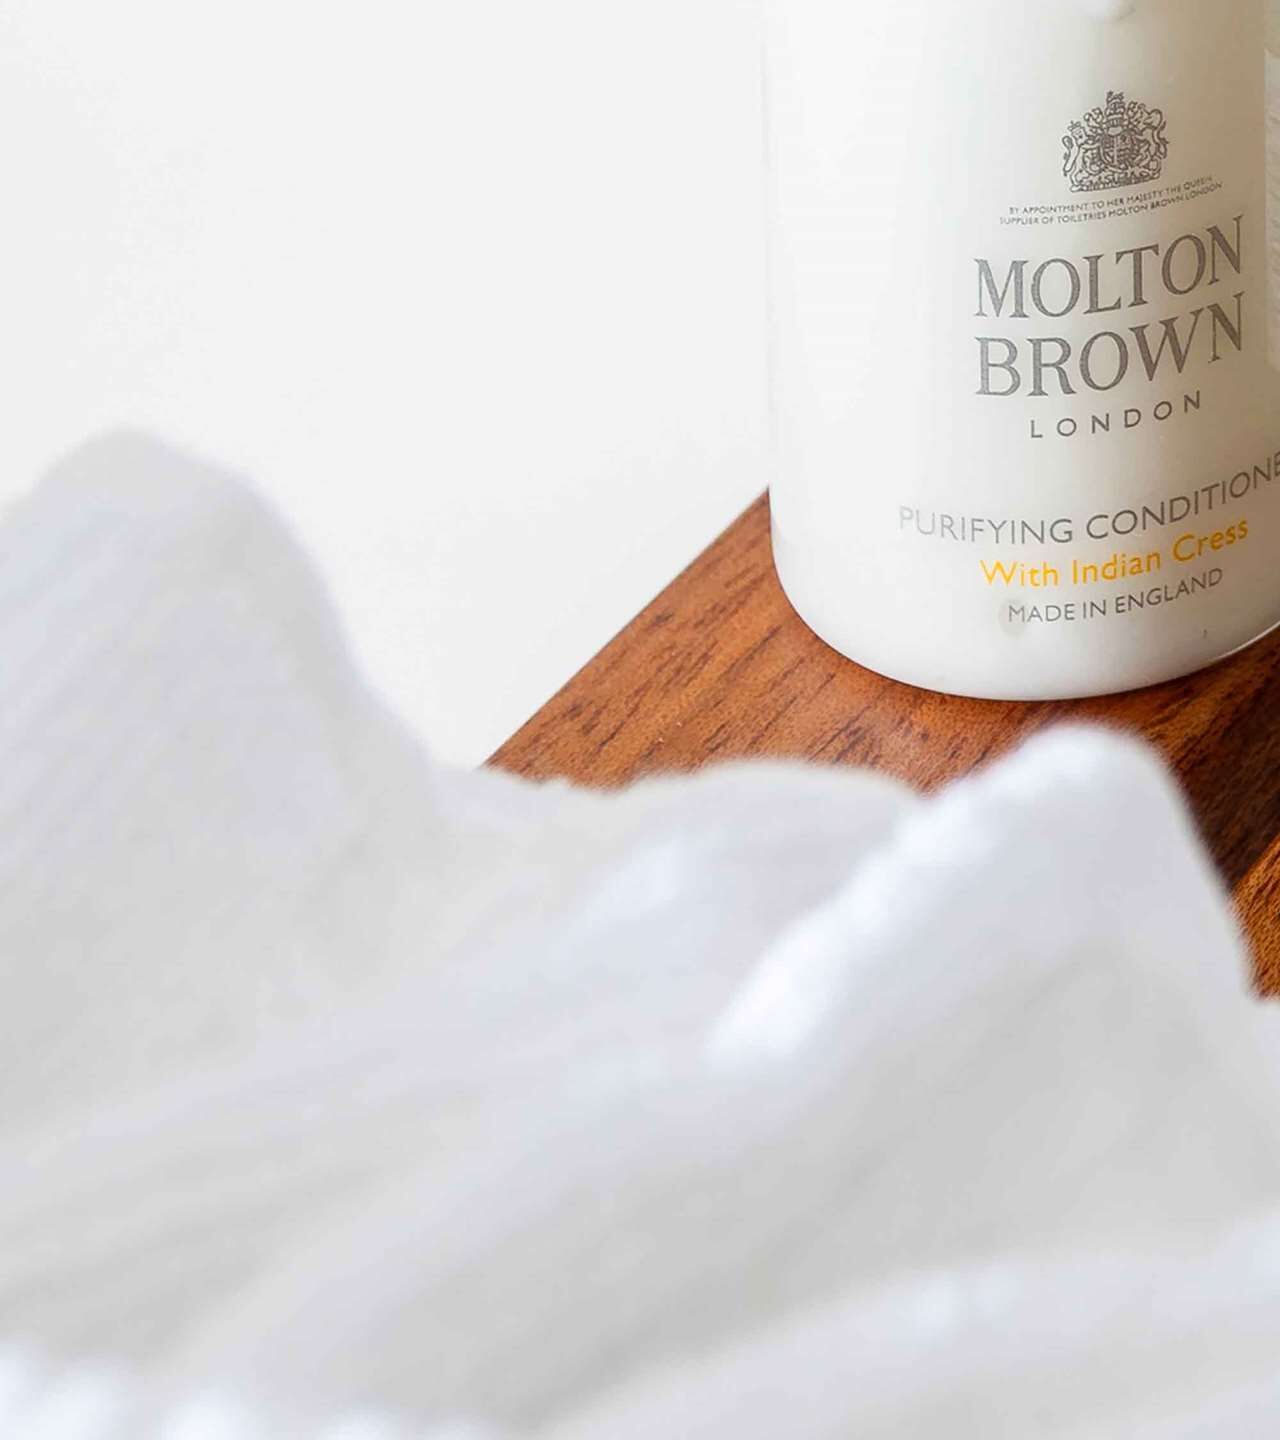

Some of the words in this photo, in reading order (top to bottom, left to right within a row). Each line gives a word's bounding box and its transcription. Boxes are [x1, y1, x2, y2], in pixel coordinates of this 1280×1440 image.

[1022, 202, 1089, 215] APPOINTMENT
[1092, 201, 1104, 210] TO
[1107, 197, 1125, 207] HER
[1126, 189, 1164, 204] MAJESTY
[1057, 211, 1107, 224] TOILETRIES
[1108, 204, 1149, 217] MOLTON
[1150, 195, 1184, 210] BROWN
[1186, 182, 1224, 201] LONDON
[974, 214, 1244, 318] MOLTON
[975, 291, 1245, 396] BROWN
[1031, 390, 1200, 438] LONDON
[899, 505, 1073, 544] PURIFYING
[979, 559, 1059, 588] With
[1072, 548, 1162, 586] Indian
[1172, 519, 1250, 562] Cress
[1008, 603, 1075, 623] MADE
[1083, 600, 1106, 619] IN
[1115, 567, 1224, 614] ENGLAND
